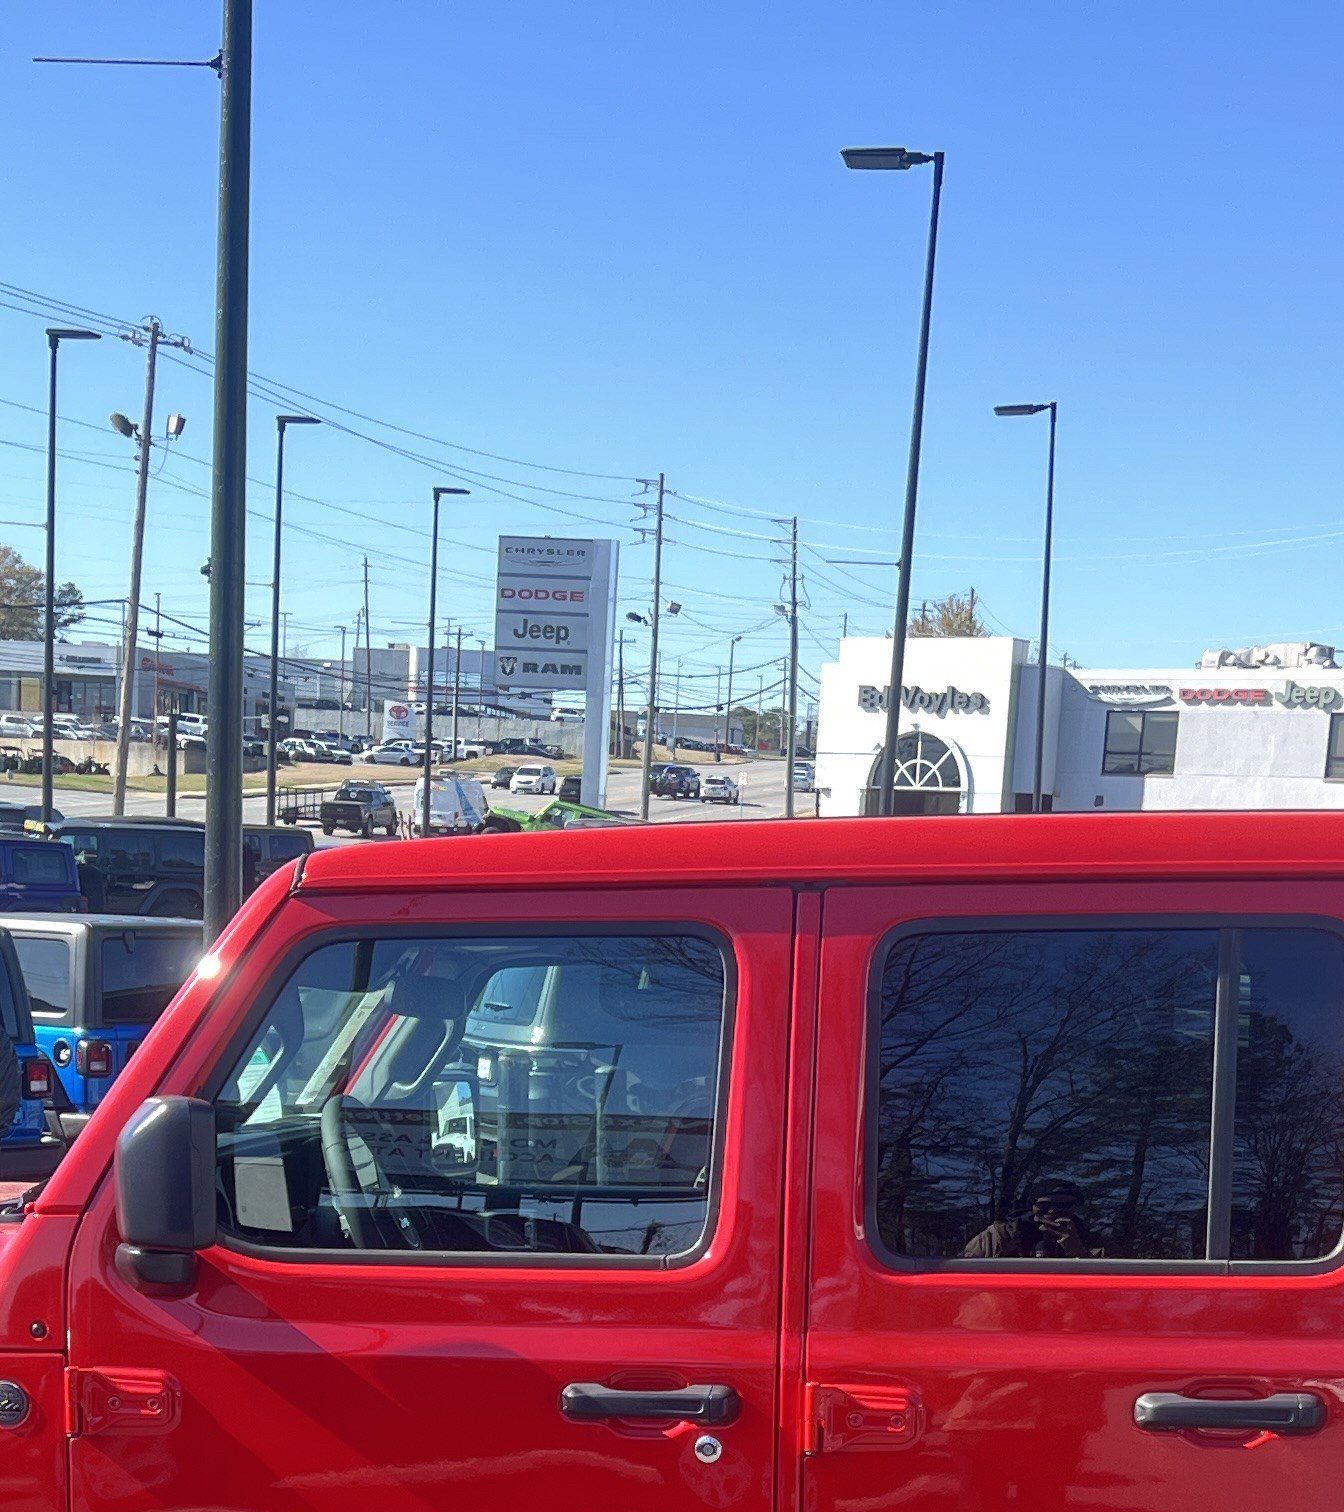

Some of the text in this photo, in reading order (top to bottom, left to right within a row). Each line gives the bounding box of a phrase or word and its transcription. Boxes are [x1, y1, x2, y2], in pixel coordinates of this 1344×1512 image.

[504, 546, 587, 558] CHRYSLER
[500, 587, 585, 602] DODGE
[513, 618, 571, 645] Jeep
[522, 661, 582, 676] RAM
[899, 685, 989, 717] Voyles
[1178, 688, 1267, 702] DODGE
[1275, 680, 1337, 709] Jeep
